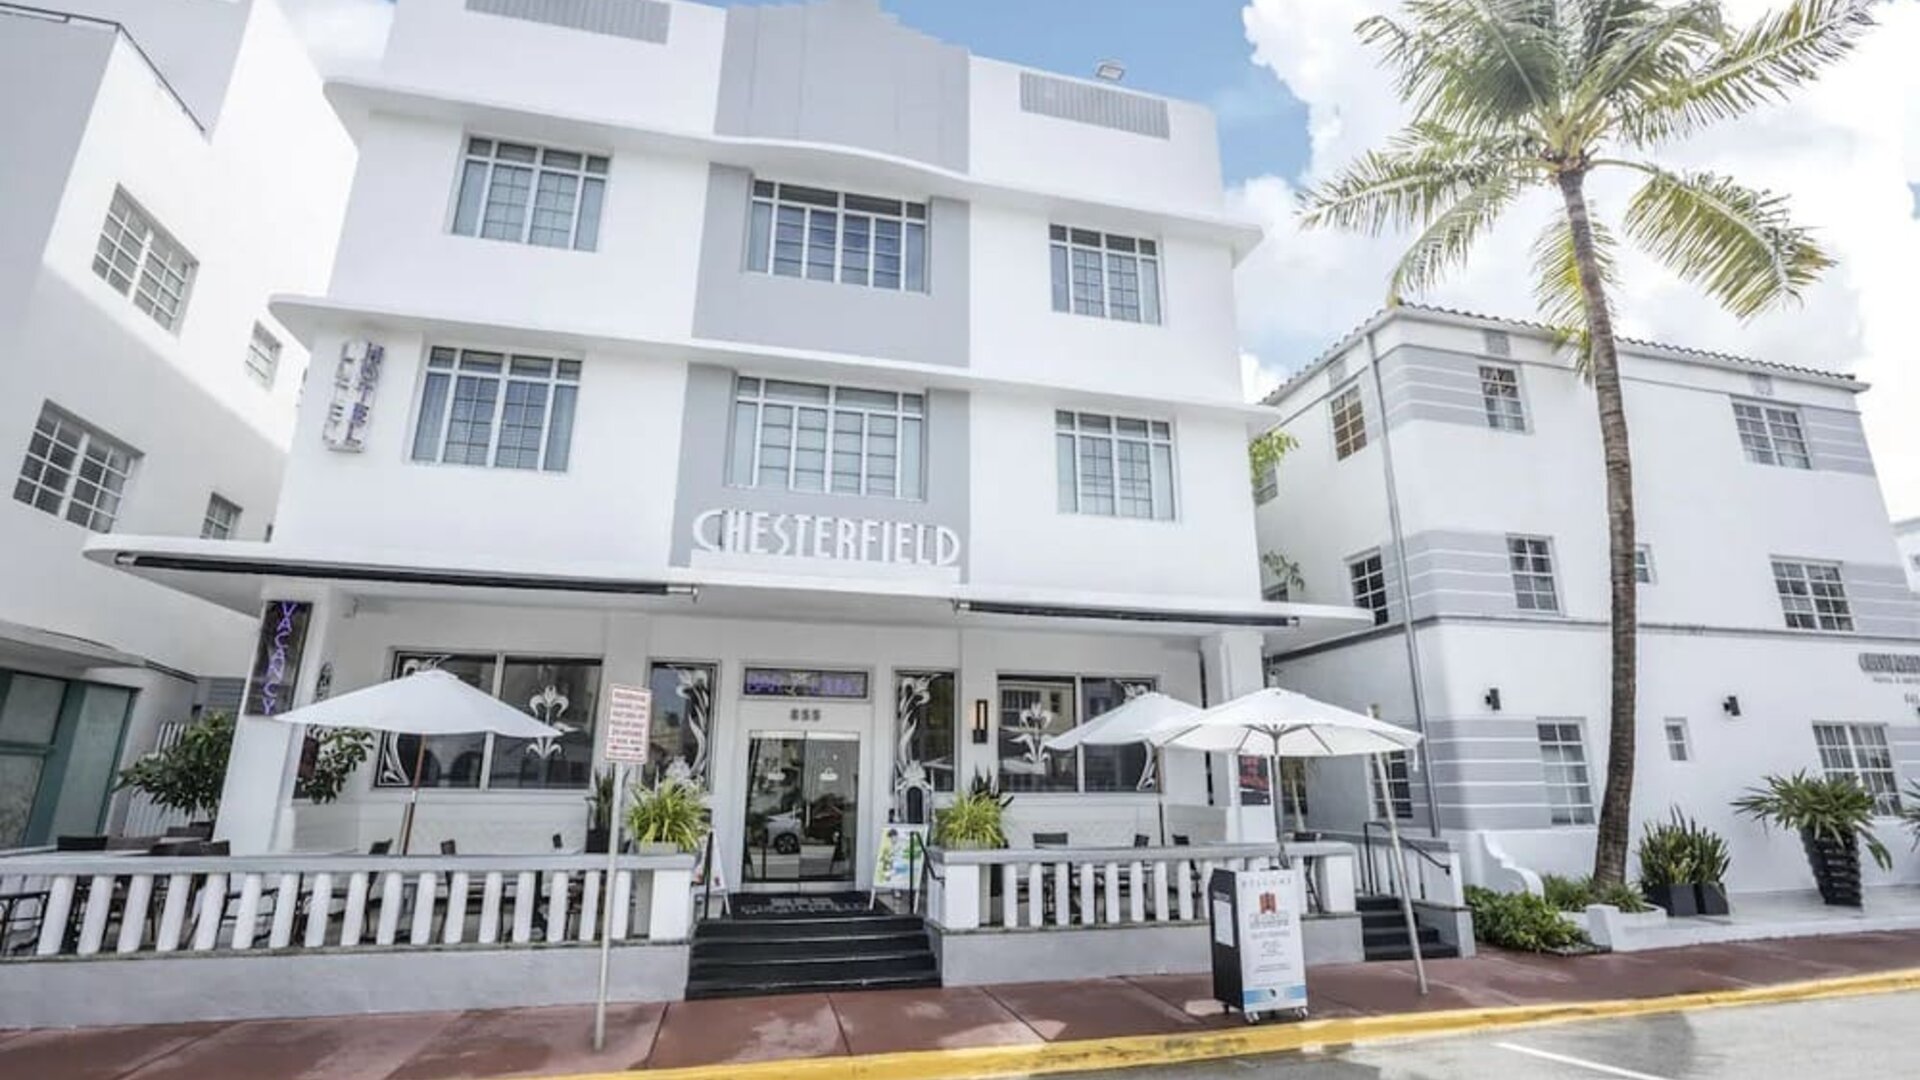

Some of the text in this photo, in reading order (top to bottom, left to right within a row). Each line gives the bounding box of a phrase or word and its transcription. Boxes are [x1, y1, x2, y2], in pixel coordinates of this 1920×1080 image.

[346, 342, 384, 446] HOTEL
[692, 508, 961, 567] CHESTERFIELD
[262, 601, 298, 715] VACANCY
